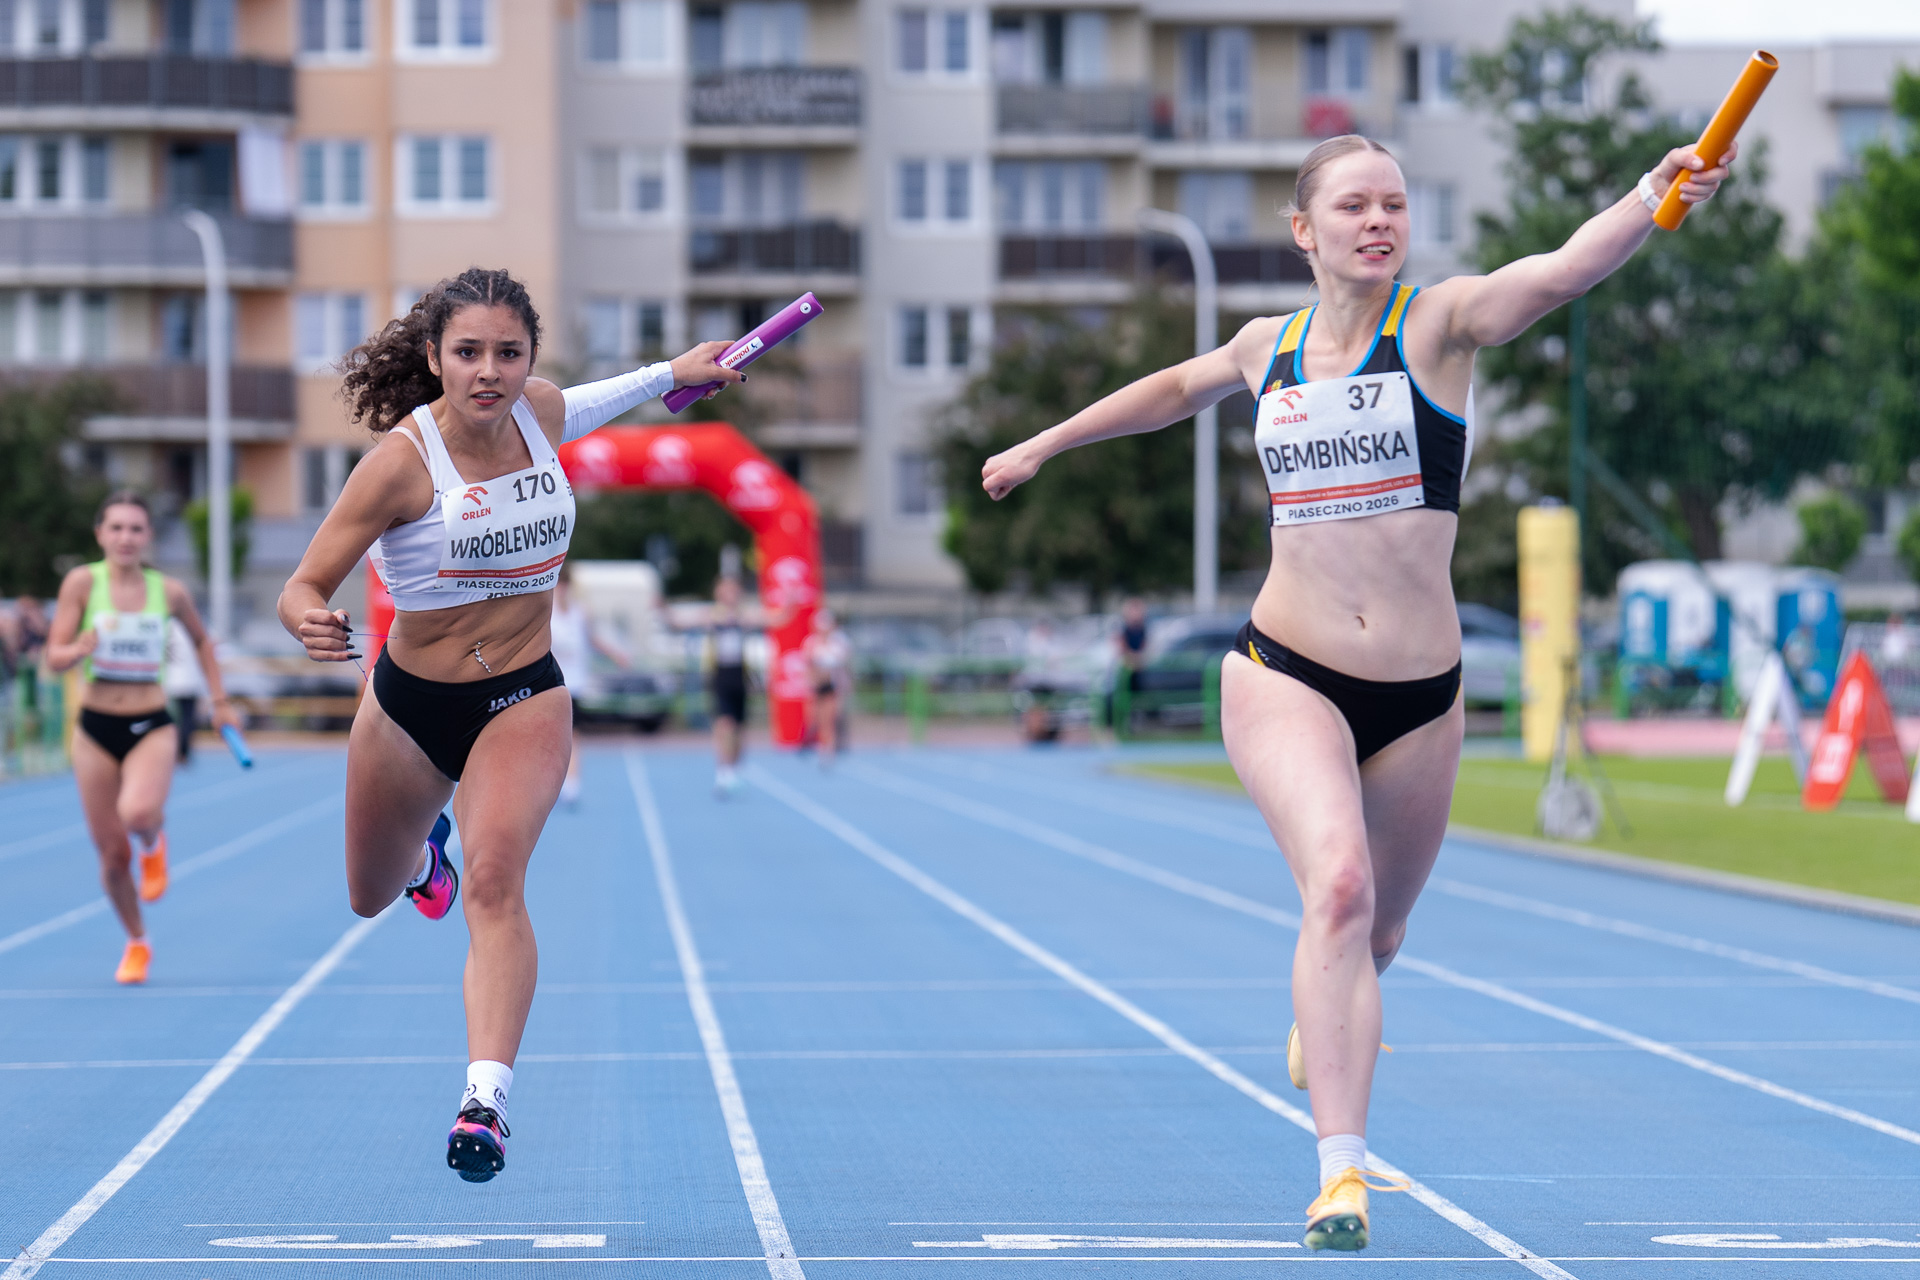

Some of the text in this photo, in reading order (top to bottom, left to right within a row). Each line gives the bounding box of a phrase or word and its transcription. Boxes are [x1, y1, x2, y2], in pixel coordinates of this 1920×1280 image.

[1347, 382, 1383, 411] 37
[1273, 412, 1308, 425] ORLEN
[1264, 429, 1411, 474] DEMBIŃSKA
[513, 471, 556, 503] 170
[462, 506, 492, 521] ORLEN
[1288, 495, 1399, 520] PIASECZNO 2026
[451, 514, 567, 559] WRÓBLEWSKA
[456, 572, 554, 589] PIASECZNO 2026
[488, 687, 532, 712] JAKO
